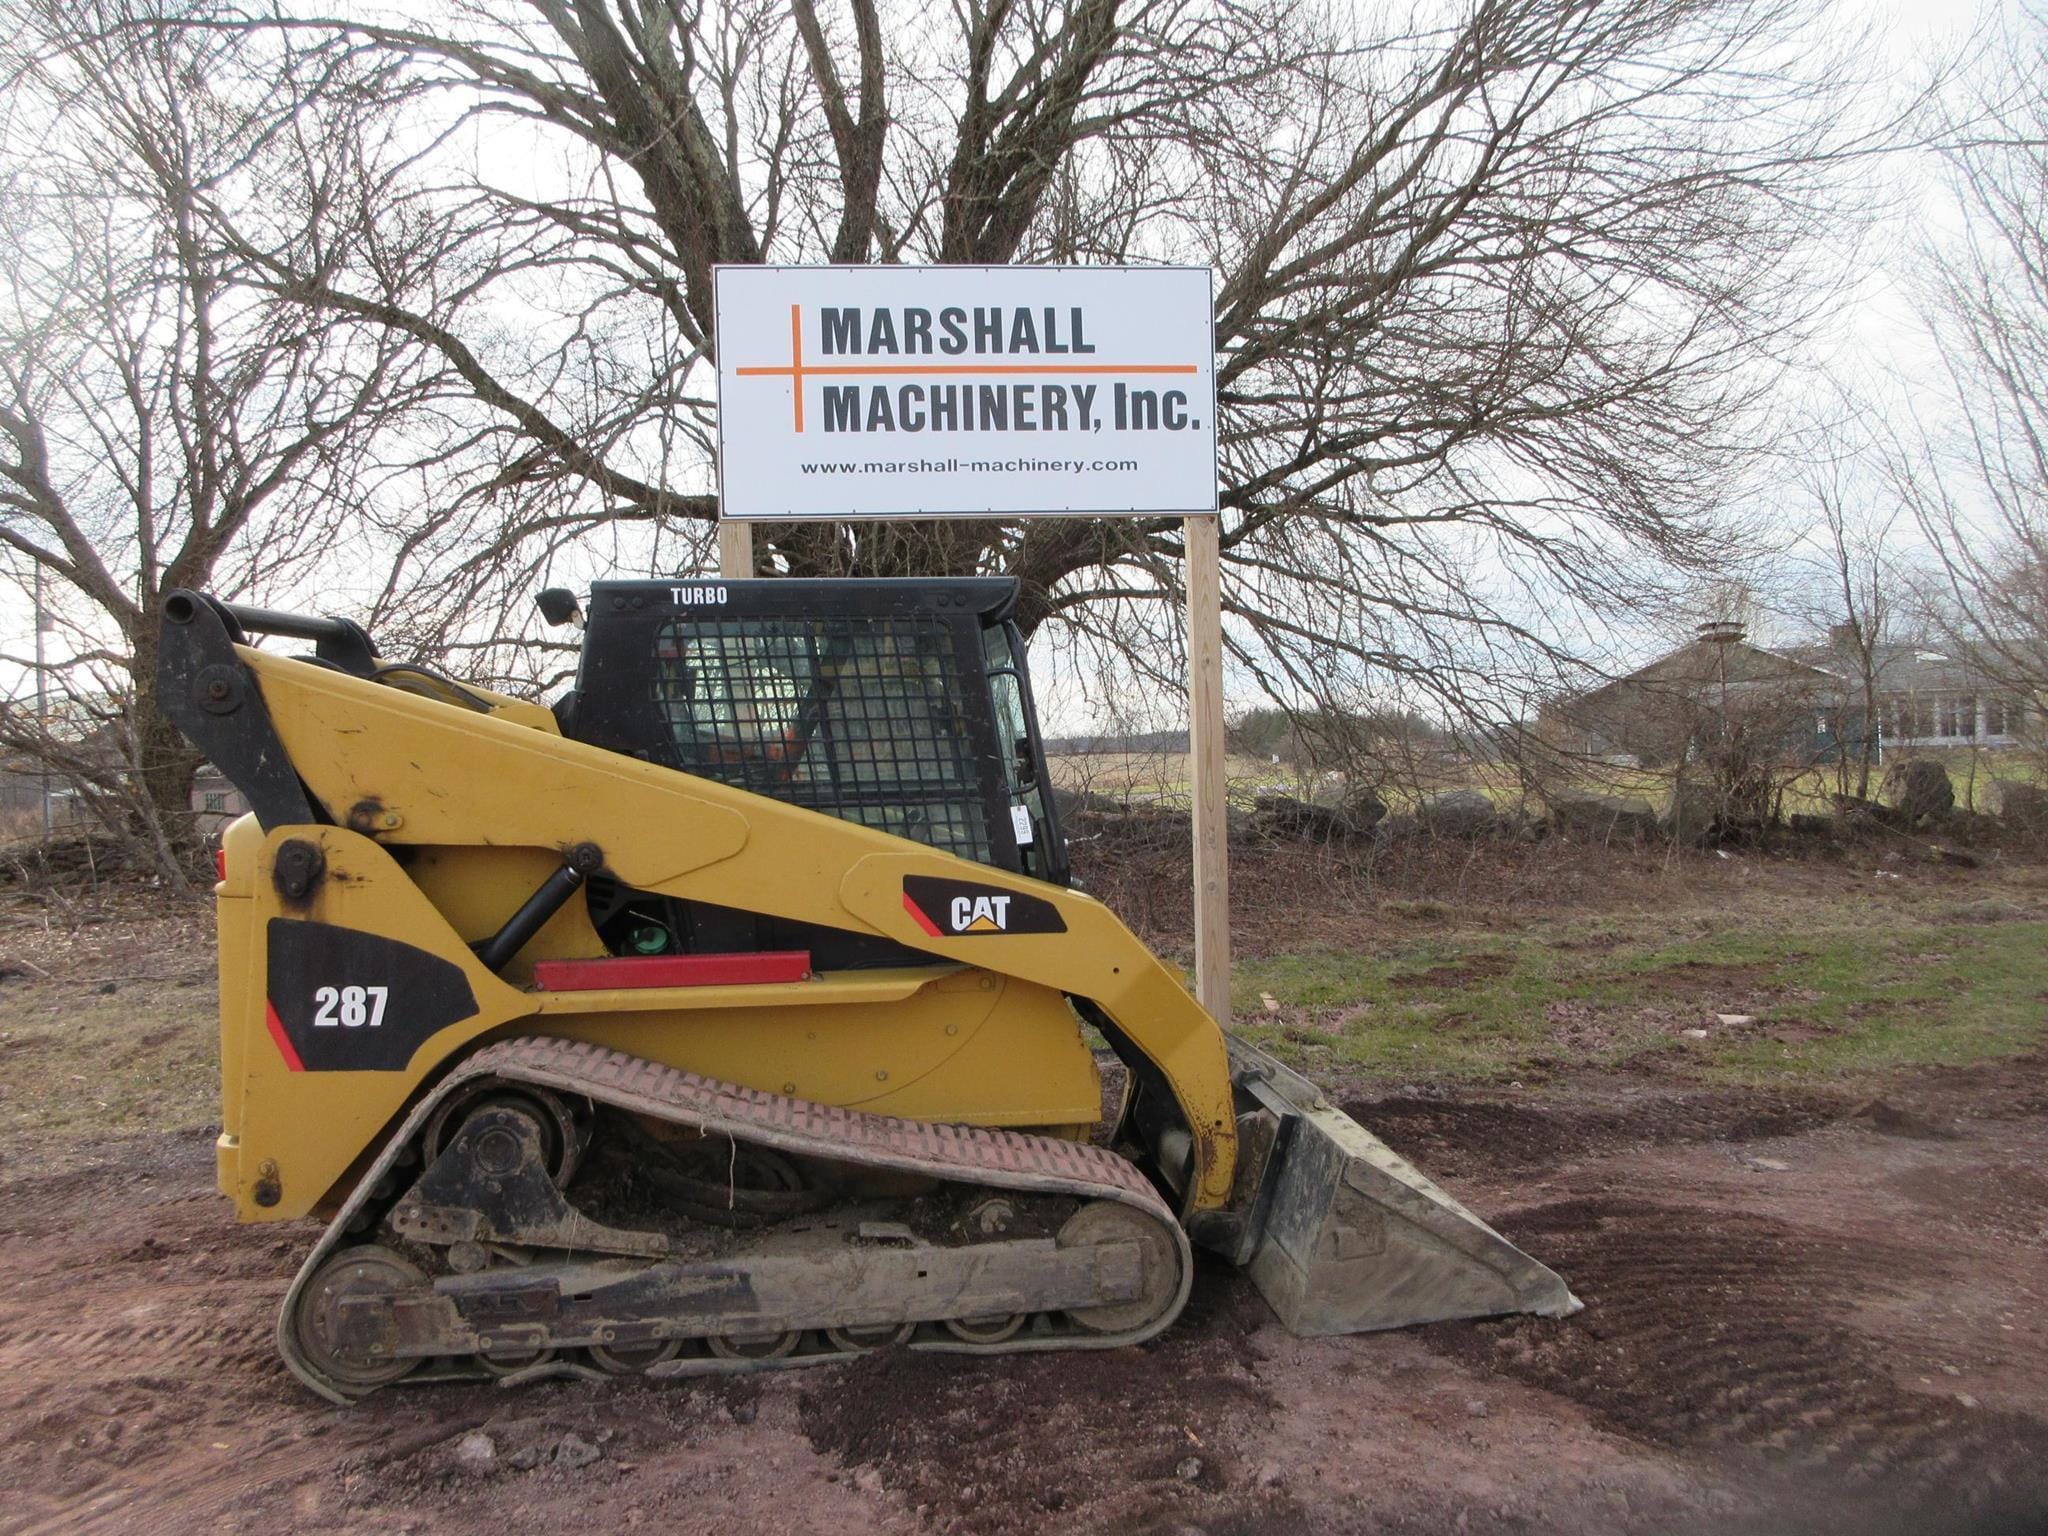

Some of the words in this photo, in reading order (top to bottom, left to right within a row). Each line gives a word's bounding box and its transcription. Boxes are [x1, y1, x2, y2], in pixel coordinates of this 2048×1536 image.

[821, 307, 1096, 355] MARSHALL
[822, 384, 1102, 434] MACHINERY,
[1114, 382, 1200, 431] Inc.
[801, 457, 1138, 474] www.marshall-machinery.com
[670, 586, 728, 605] TURBO
[951, 896, 1011, 931] CAT
[314, 985, 388, 1027] 287
